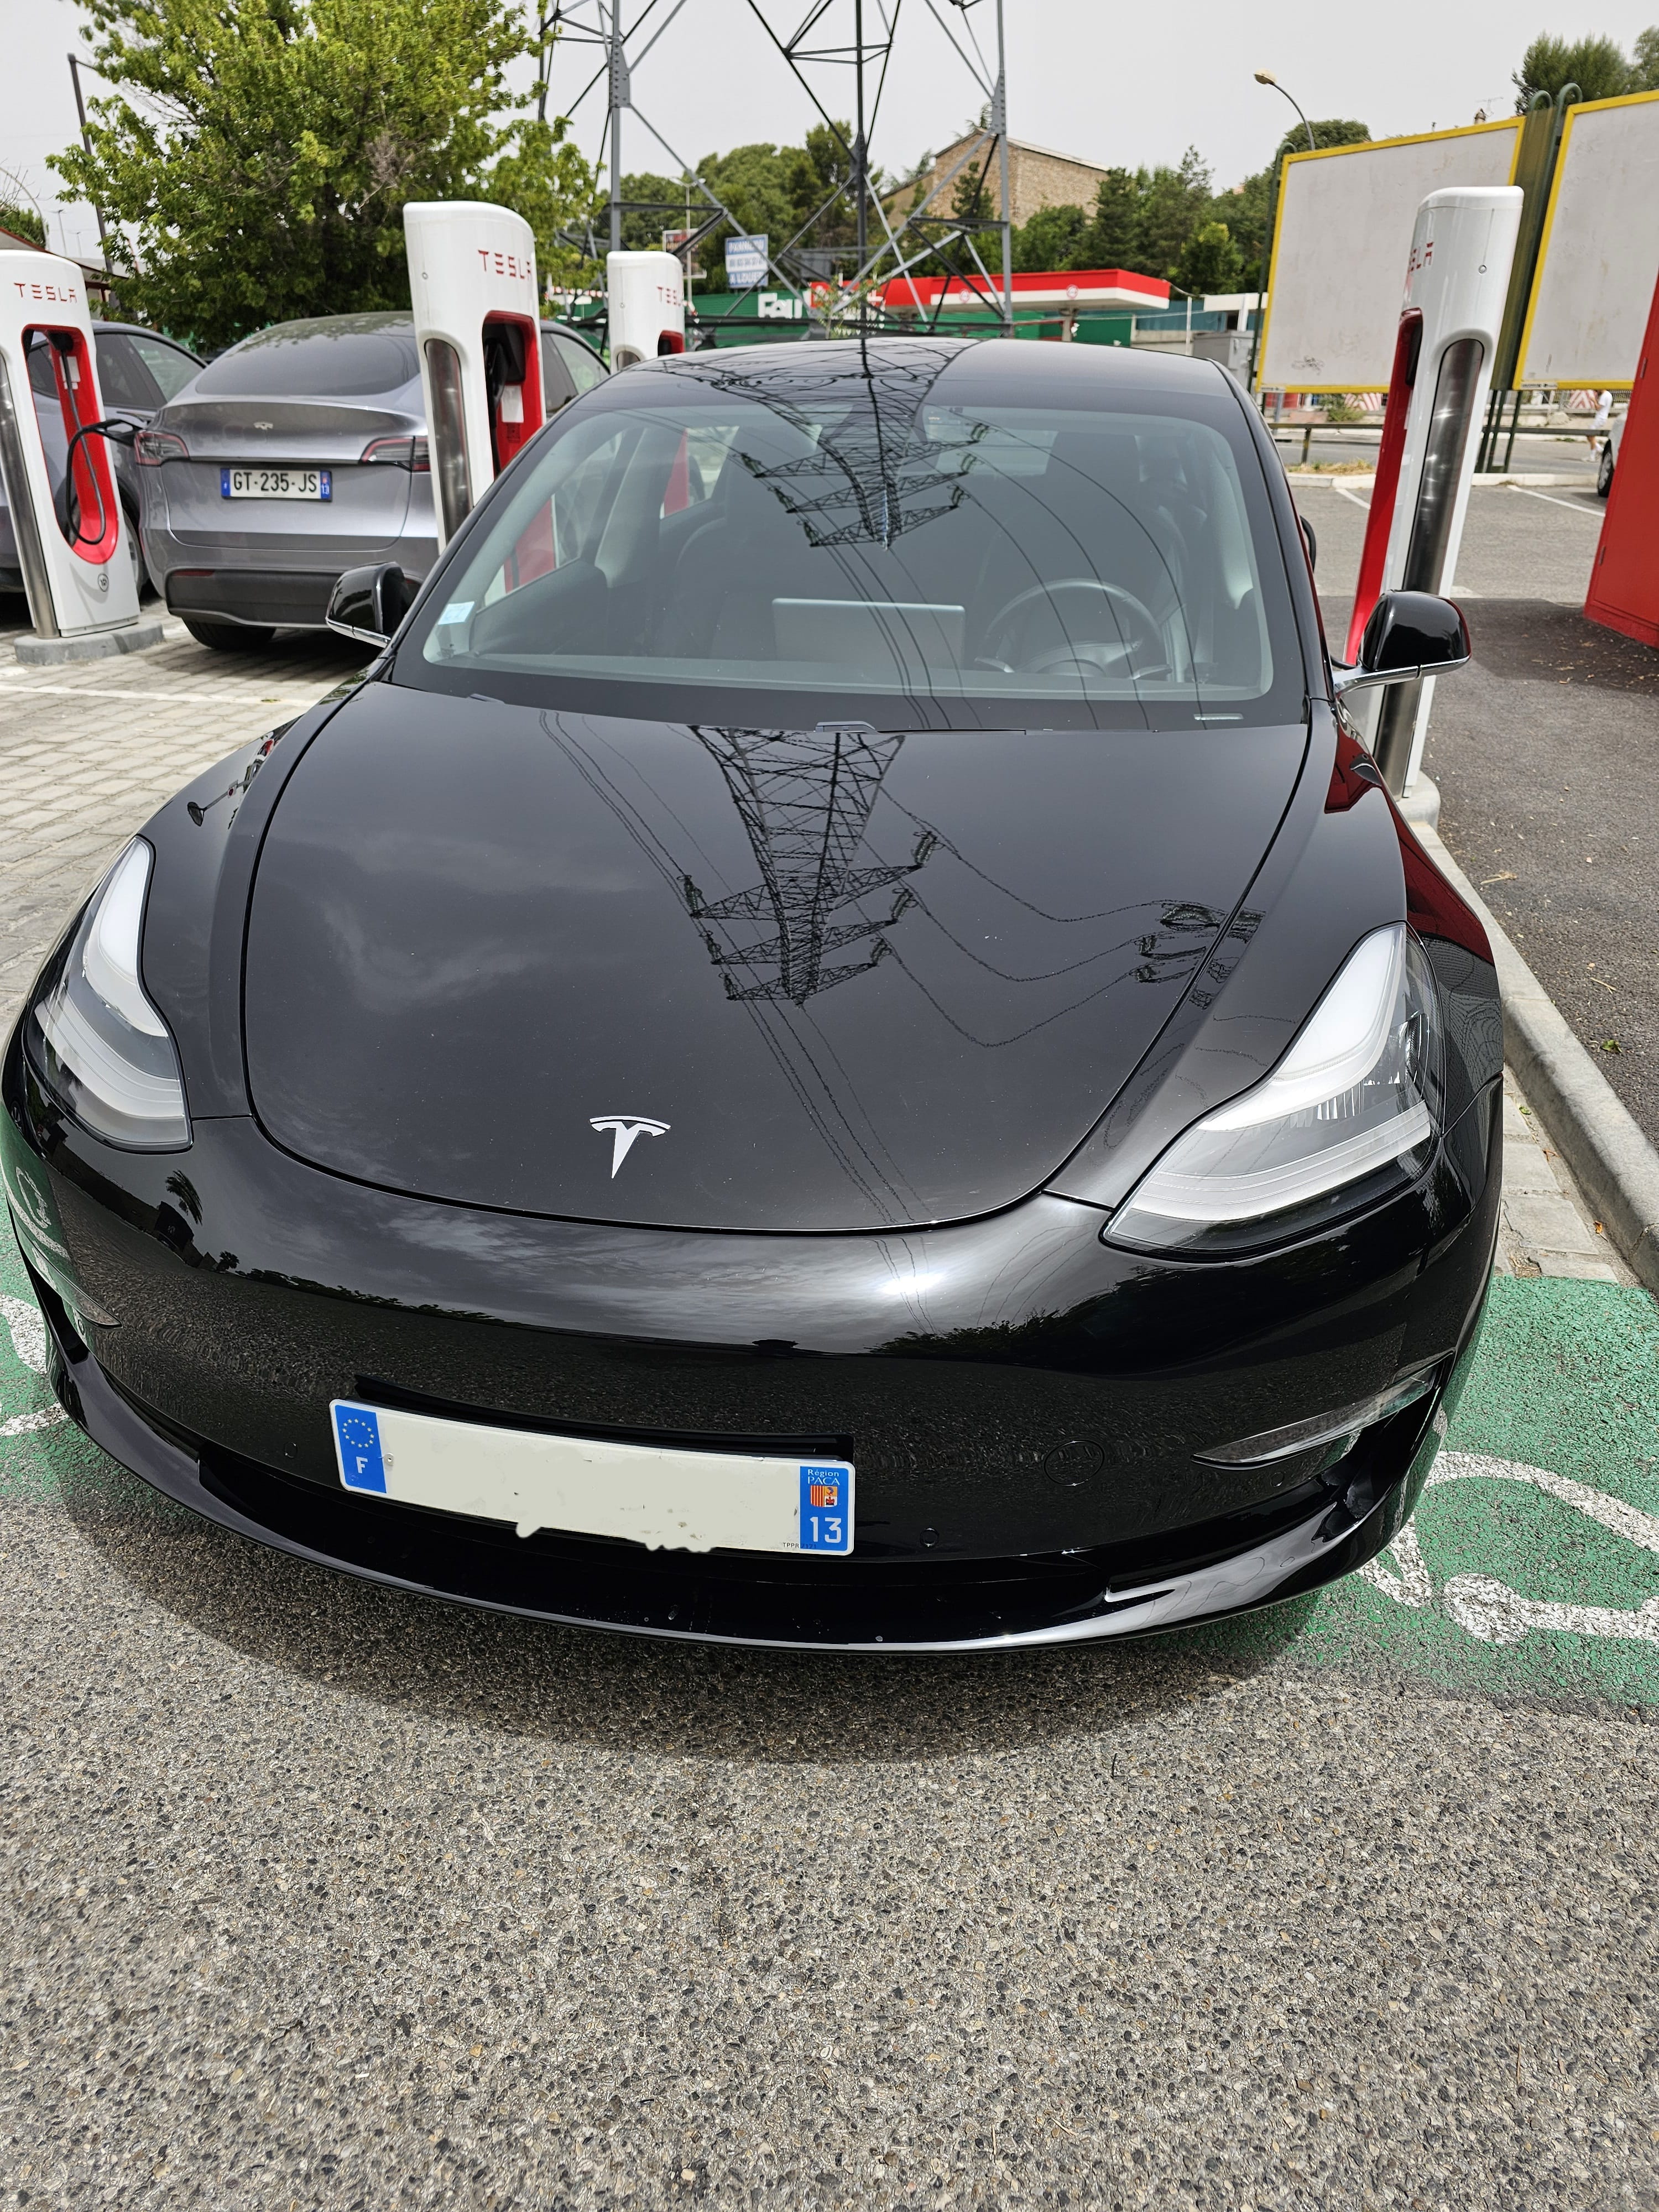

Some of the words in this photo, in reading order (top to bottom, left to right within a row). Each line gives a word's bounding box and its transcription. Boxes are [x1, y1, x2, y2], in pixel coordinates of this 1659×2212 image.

[478, 250, 533, 281] TESLA
[14, 283, 77, 304] TESLA
[356, 1456, 368, 1474] F
[807, 1469, 839, 1478] Région
[807, 1477, 841, 1485] PACA
[810, 1516, 842, 1543] 13
